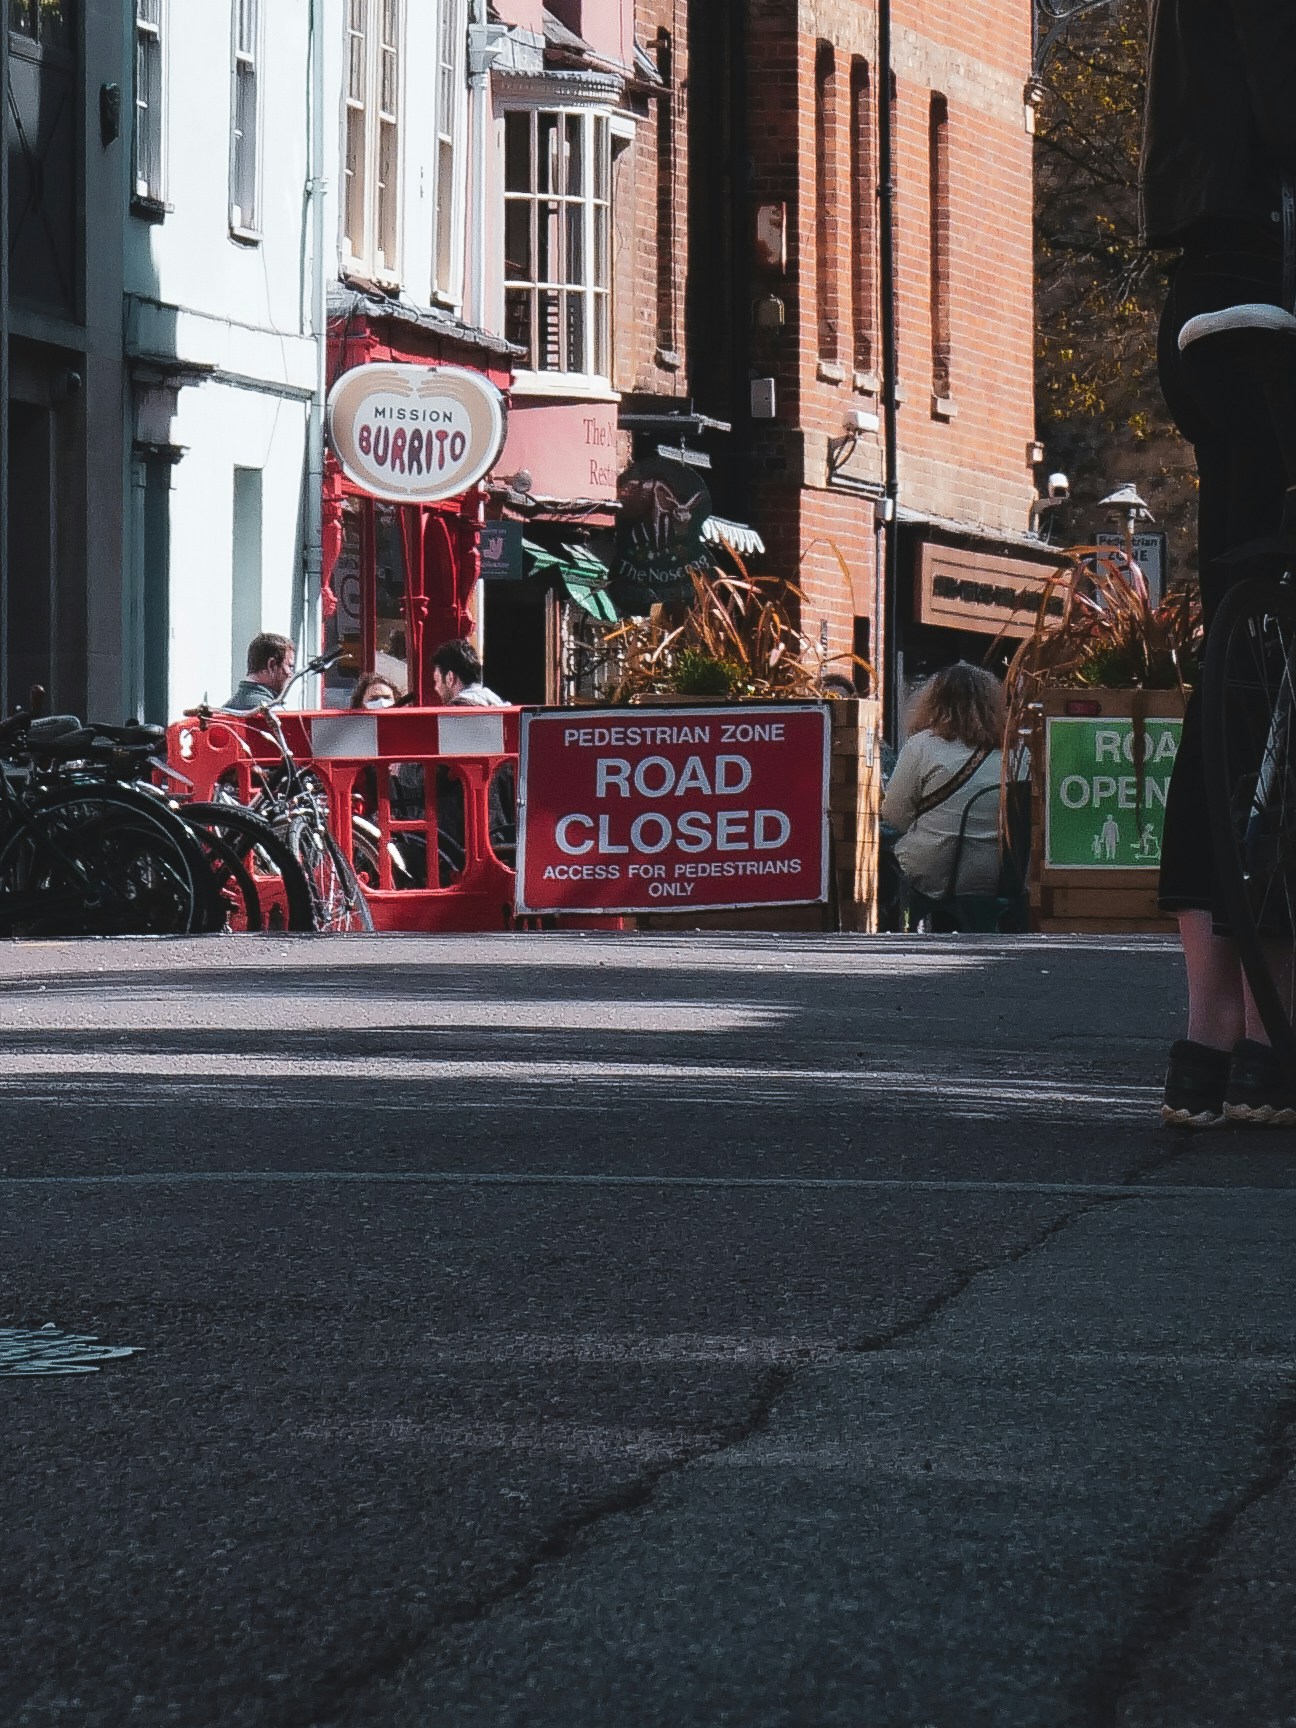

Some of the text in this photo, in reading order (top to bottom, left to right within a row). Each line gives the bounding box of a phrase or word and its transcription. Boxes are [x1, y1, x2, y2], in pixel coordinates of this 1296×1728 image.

[374, 407, 453, 423] MISSION
[583, 417, 606, 446] The
[359, 424, 466, 476] BURRITO
[620, 559, 647, 582] The
[564, 724, 785, 747] PEDESTRIAN ZONE
[1096, 731, 1179, 762] ROA
[596, 755, 752, 798] ROAD
[1060, 775, 1171, 809] OPEN
[555, 809, 791, 855] CLOSED
[543, 859, 801, 880] ACCESS FOR PEDESTRIANS
[648, 883, 695, 897] ONLY
